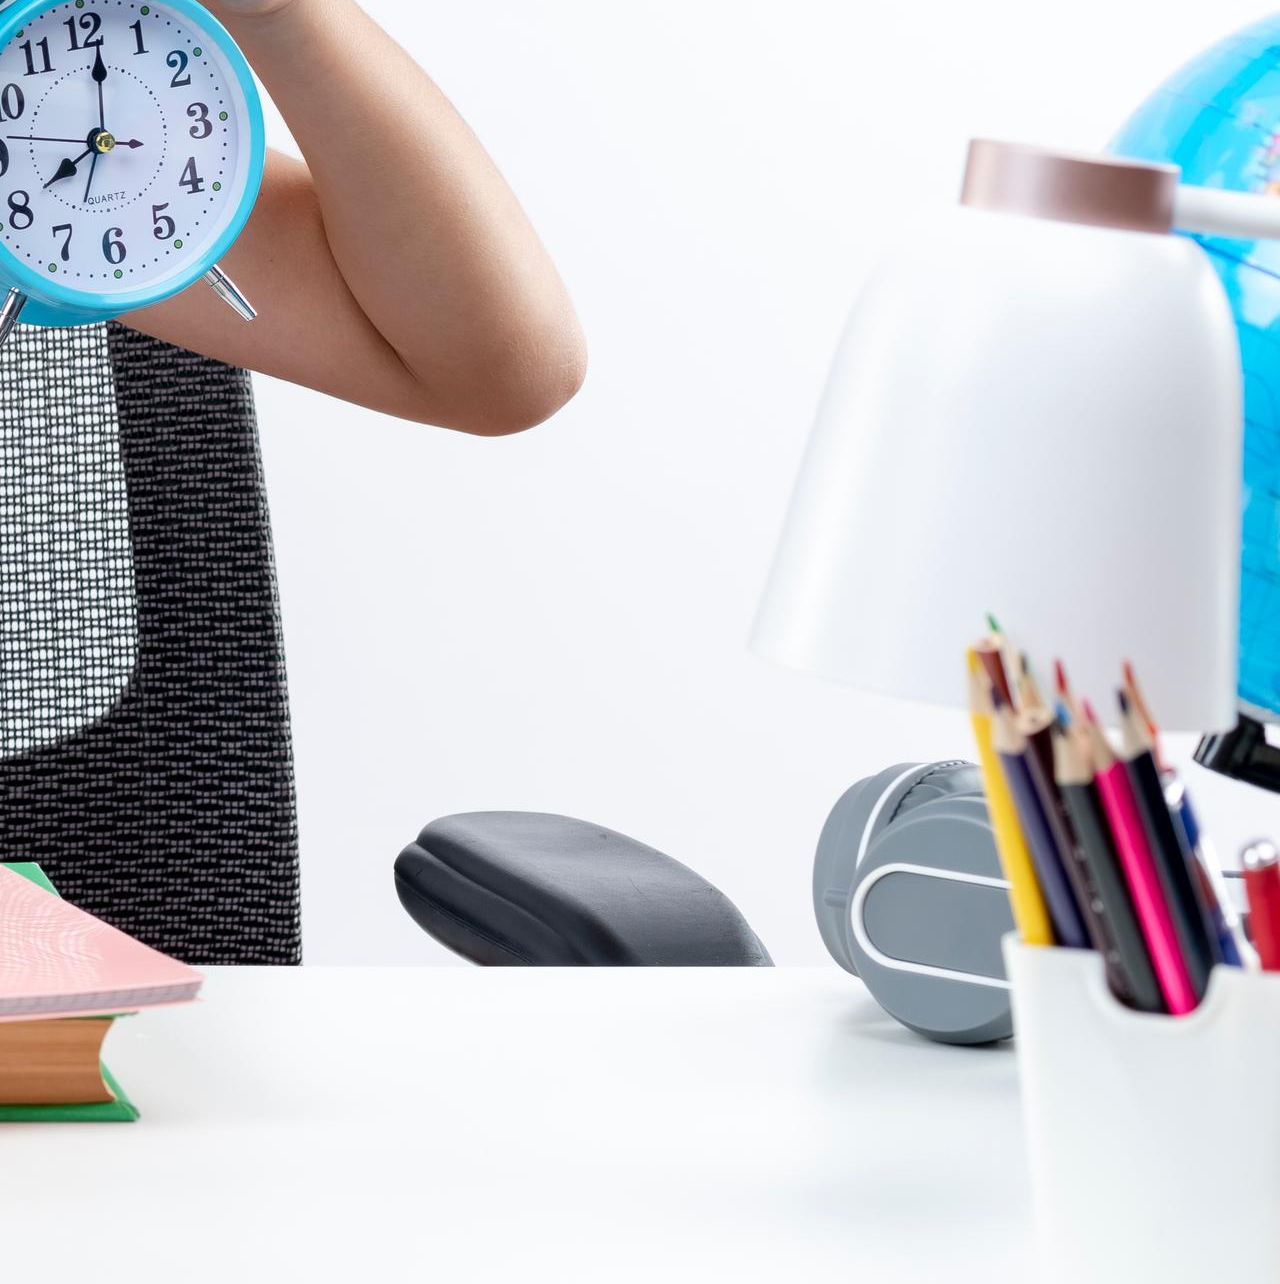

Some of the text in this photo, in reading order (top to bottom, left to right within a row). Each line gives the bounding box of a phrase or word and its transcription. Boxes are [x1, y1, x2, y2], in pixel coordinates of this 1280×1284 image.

[63, 12, 104, 52] 12
[129, 19, 150, 56] 1
[19, 36, 57, 76] 11
[166, 49, 192, 88] 2
[186, 102, 213, 139] 3
[178, 156, 205, 195] 4
[7, 190, 35, 230] 8
[87, 191, 127, 205] QUARTZ
[152, 202, 176, 240] 5
[51, 223, 73, 262] 7
[102, 227, 127, 265] 6
